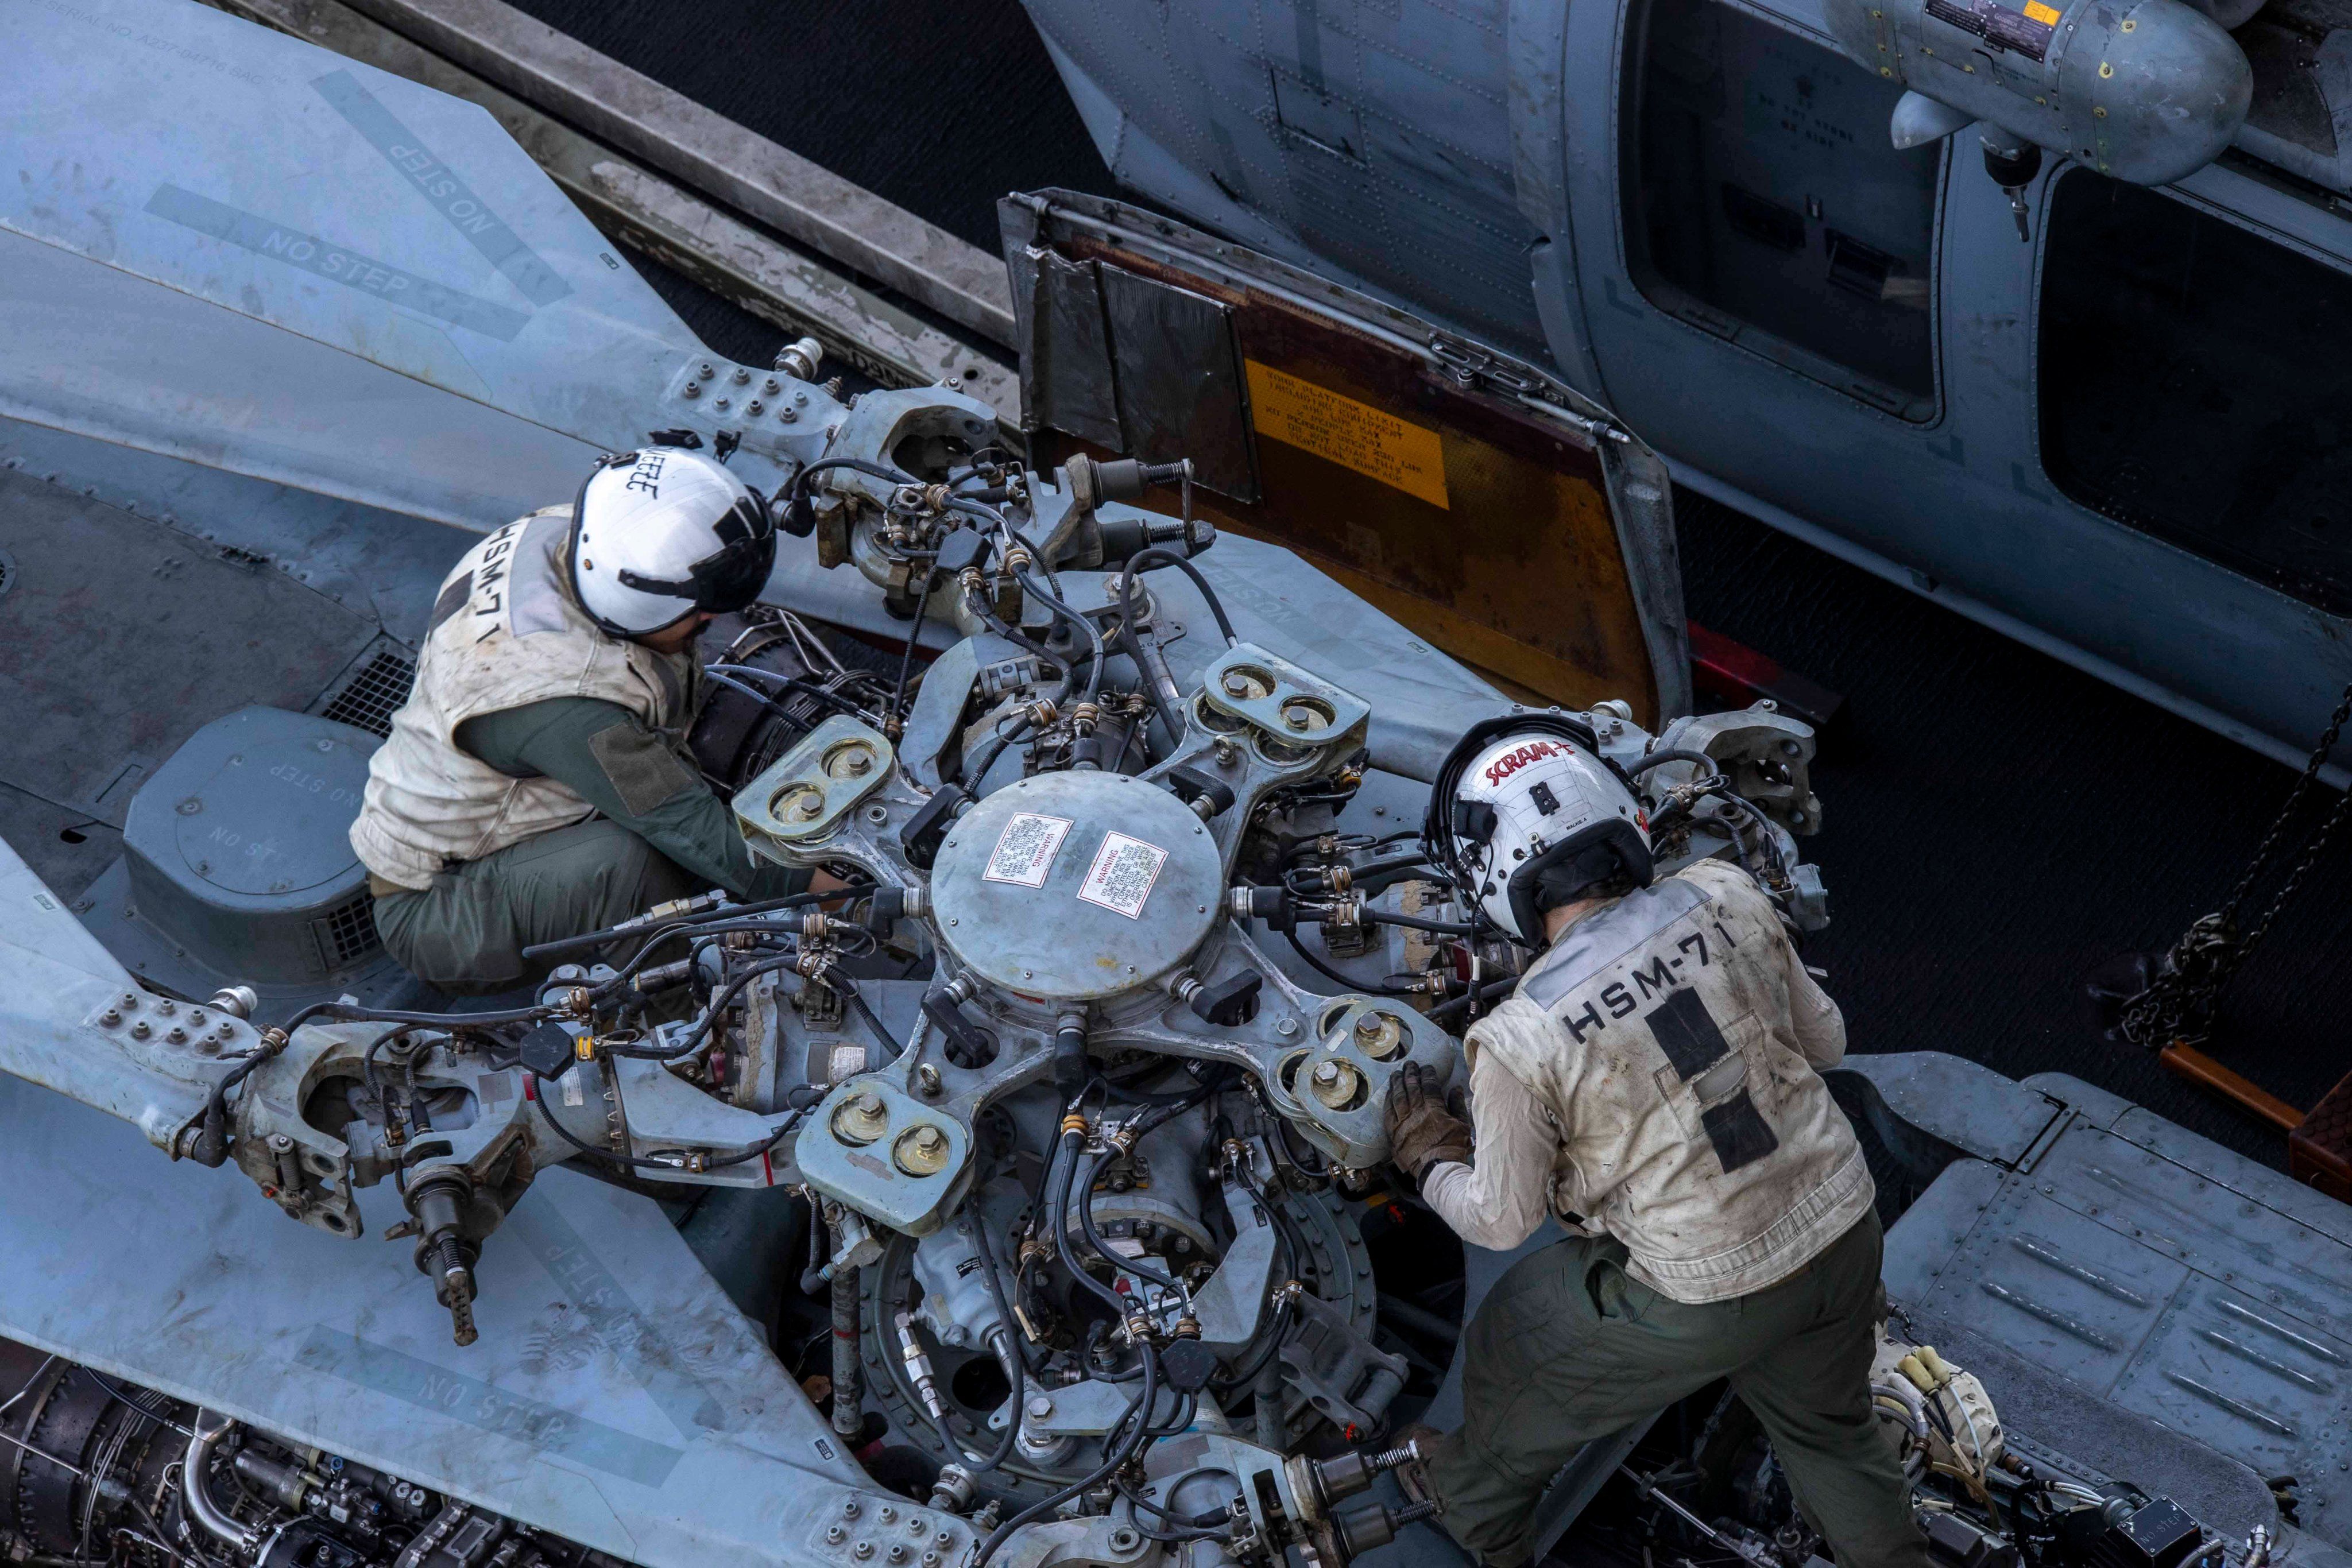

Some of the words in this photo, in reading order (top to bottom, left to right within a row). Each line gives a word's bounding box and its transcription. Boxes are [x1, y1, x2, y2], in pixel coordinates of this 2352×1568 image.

[45, 0, 102, 28] SERIAL
[390, 144, 458, 195] STEP
[451, 201, 497, 235] NO
[262, 230, 316, 261] NO
[320, 253, 409, 295] STEP
[475, 522, 519, 644] HSM-71
[1486, 741, 1557, 787] SCRAM
[270, 764, 326, 793] STEP
[330, 788, 362, 808] NO
[208, 825, 241, 847] NO
[1007, 823, 1017, 835] FIRES
[1019, 819, 1030, 833] EITHER
[1030, 823, 1044, 843] JUNCTION
[1037, 832, 1045, 840] NOT
[1002, 838, 1010, 846] CAN
[1009, 836, 1021, 851] ENGINE
[1027, 843, 1039, 861] REMOVE
[1031, 834, 1054, 866] WARNING
[1137, 846, 1147, 859] WHILE
[993, 850, 1004, 866] RESULT
[995, 853, 1008, 872] SERIOUS
[1009, 860, 1020, 876] POWER
[1016, 858, 1027, 873] COVER
[1096, 849, 1119, 884] WARNING
[1105, 876, 1113, 886] NOT
[1111, 855, 1123, 874] REMOVE
[1121, 843, 1129, 854] THIS
[1143, 853, 1156, 870] SERIOUS
[1003, 862, 1014, 877] WHILE
[1020, 865, 1029, 875] THIS
[1105, 873, 1121, 897] JUNCTION
[1124, 846, 1134, 860] COVER
[1109, 888, 1120, 903] WHILE
[1118, 862, 1132, 885] EXTERNAL
[1130, 845, 1141, 861] POWER
[1120, 889, 1132, 906] EITHER
[1129, 870, 1142, 886] ENGINE
[1134, 890, 1144, 903] FIRES
[1141, 878, 1150, 888] CAN
[1147, 860, 1158, 876] RESULT
[1562, 920, 1738, 1045] HSM-71
[417, 1374, 467, 1407] NO
[477, 1393, 566, 1441] STEP
[2140, 1530, 2156, 1544] NO
